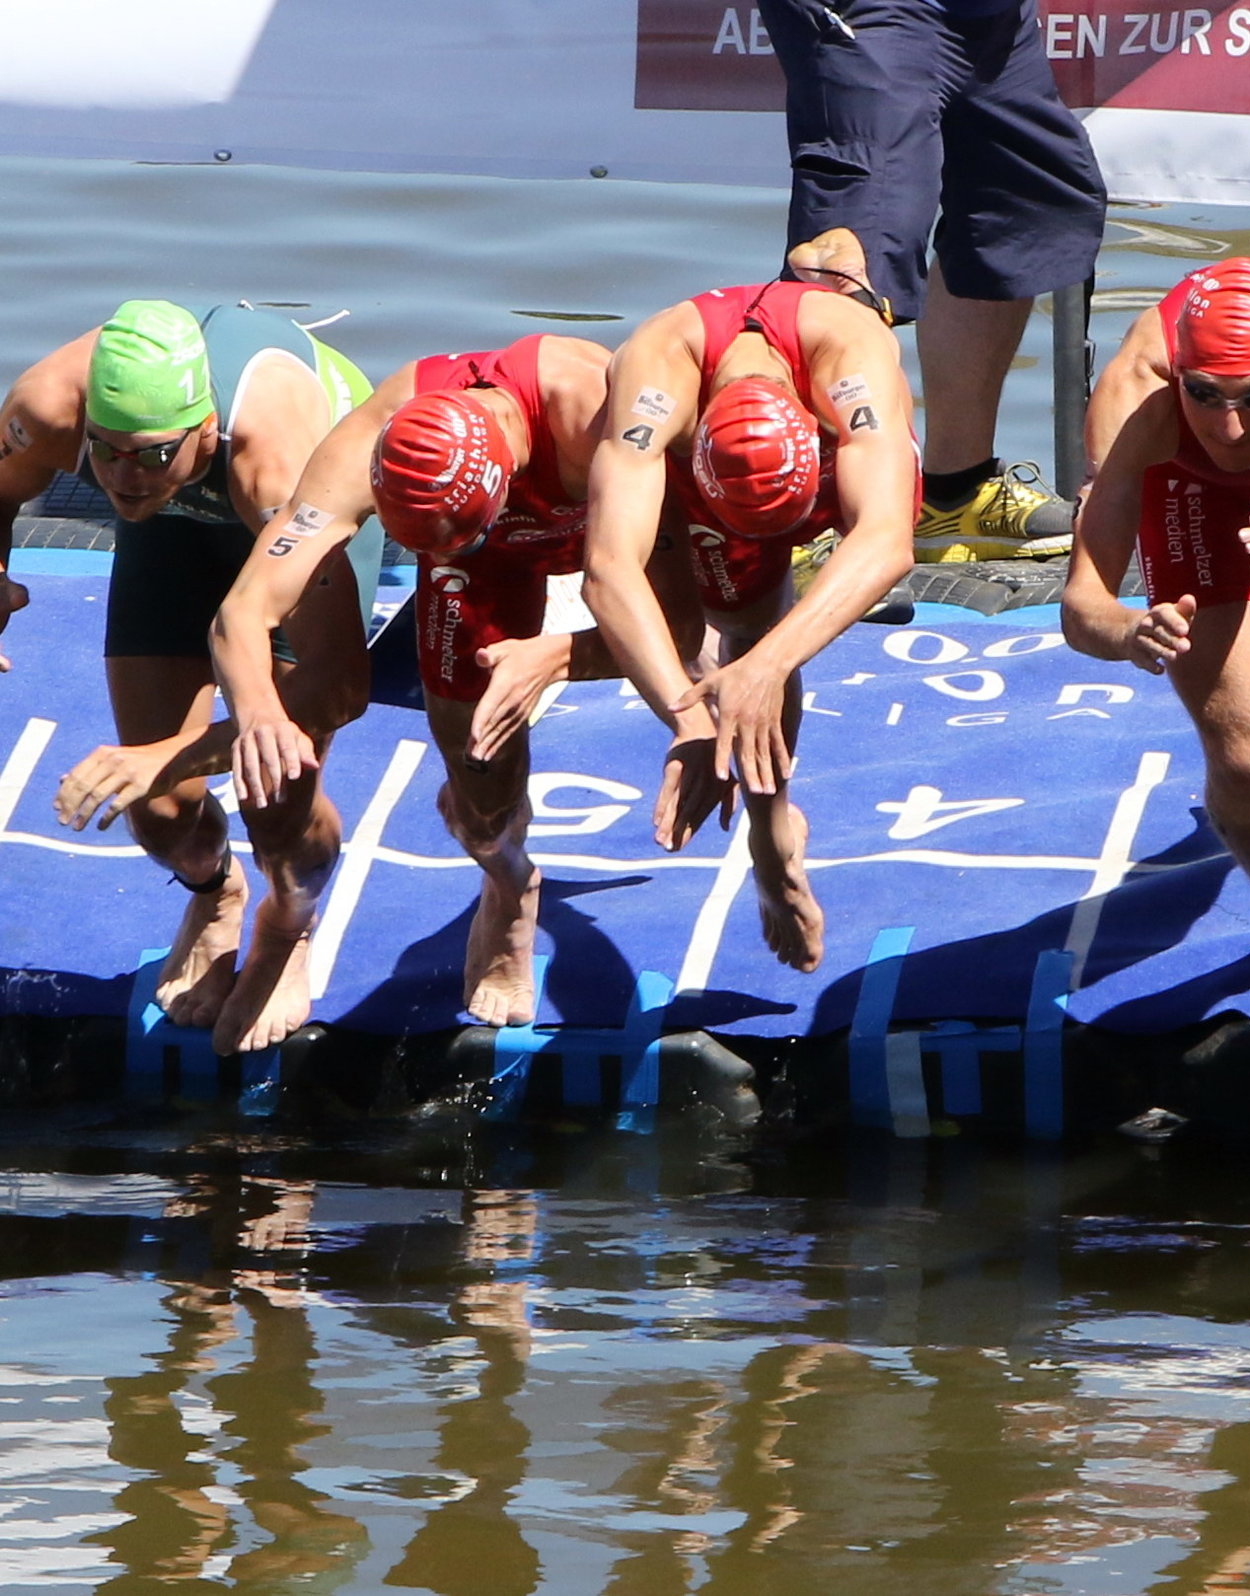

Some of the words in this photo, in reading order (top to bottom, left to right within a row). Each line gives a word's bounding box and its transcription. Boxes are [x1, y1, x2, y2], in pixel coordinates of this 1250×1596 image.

[1118, 8, 1212, 56] ZUR
[622, 423, 654, 451] 4
[850, 405, 879, 432] 4
[444, 413, 482, 505] triathlon
[481, 459, 502, 499] 5
[267, 536, 299, 557] 5
[1164, 498, 1185, 563] medien
[1187, 496, 1214, 587] schmelzer
[441, 598, 463, 682] schmelzer
[527, 771, 644, 837] 5
[874, 785, 1025, 840] 4
